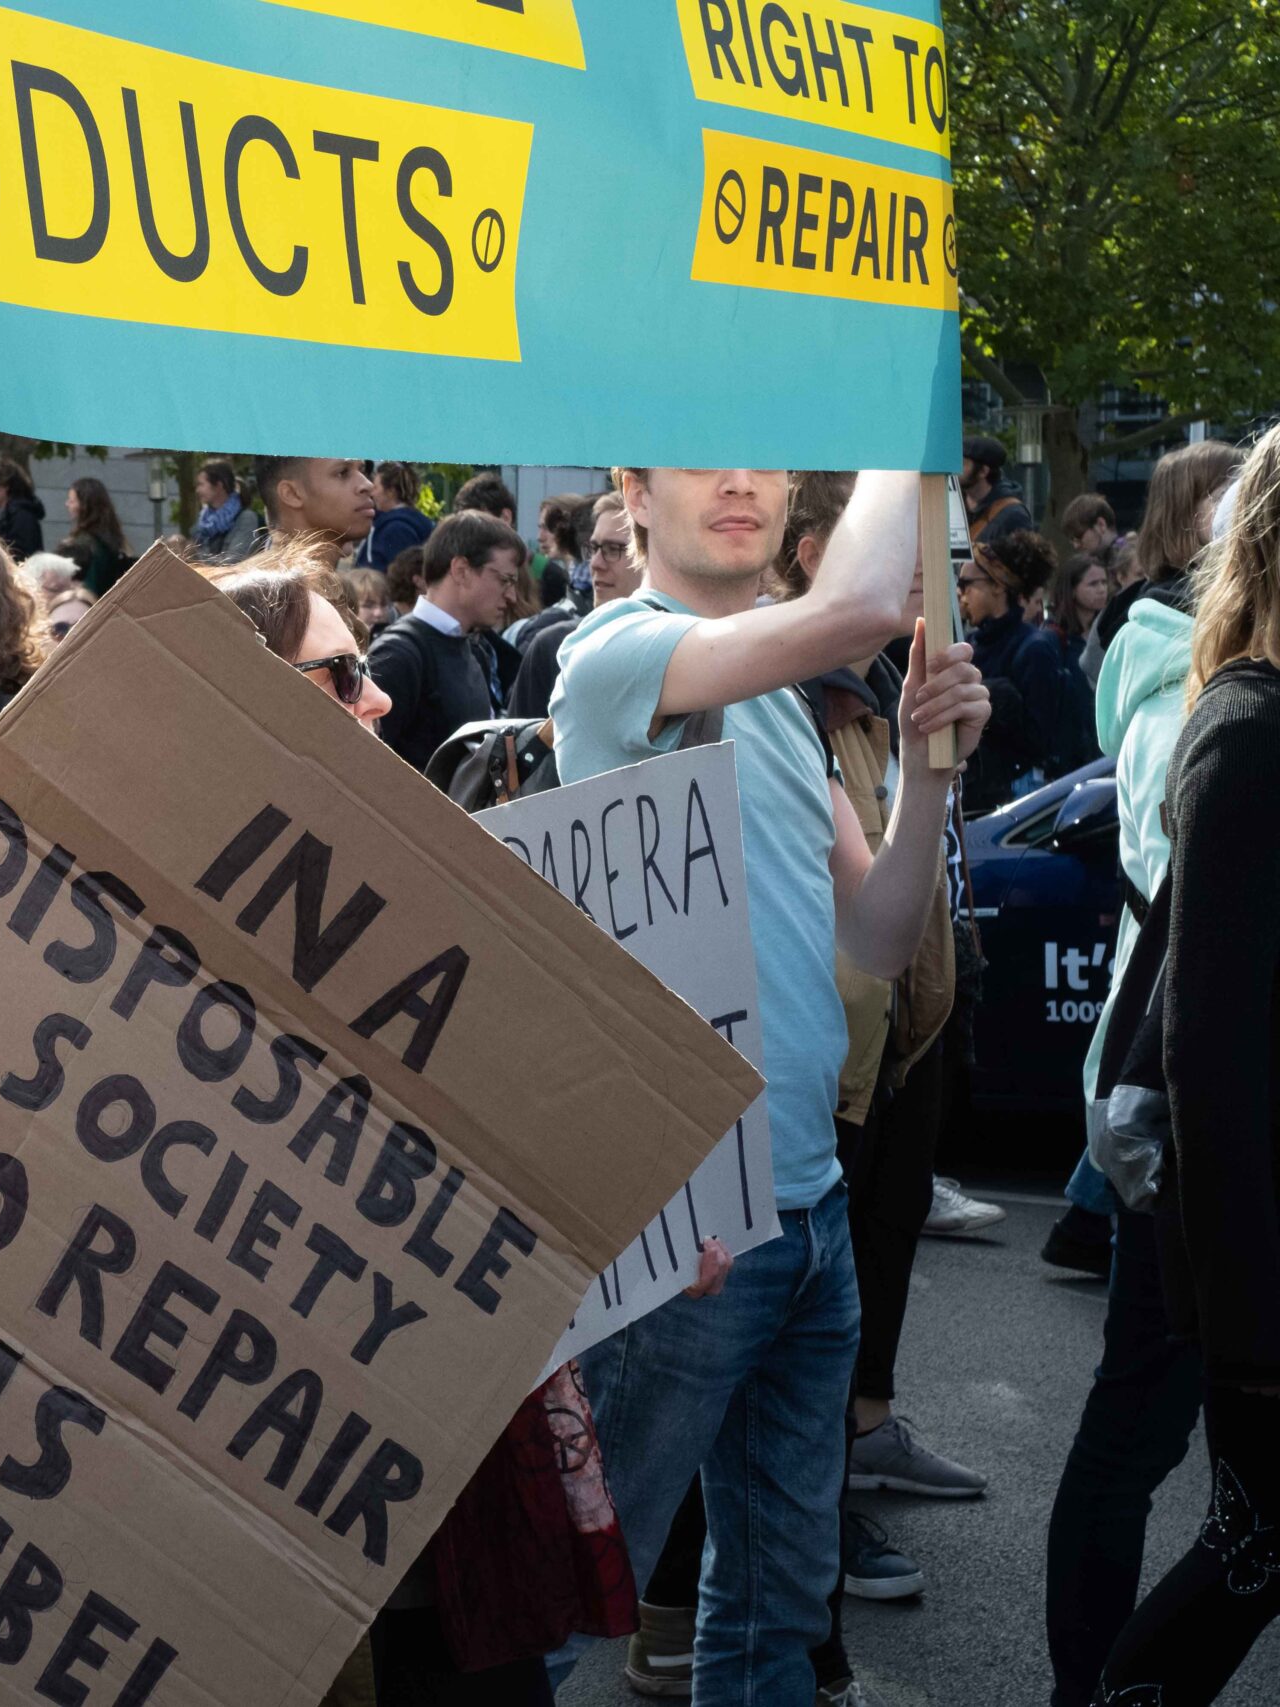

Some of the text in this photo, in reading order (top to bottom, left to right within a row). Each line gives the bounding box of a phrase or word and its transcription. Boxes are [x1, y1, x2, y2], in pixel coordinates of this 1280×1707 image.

[698, 0, 948, 135] RIGHT TO
[756, 165, 930, 286] REPAIR
[502, 777, 729, 940] ARERA
[194, 803, 471, 1075] IN A
[1045, 941, 1116, 990] It'
[35, 1203, 425, 1568] REPAIR
